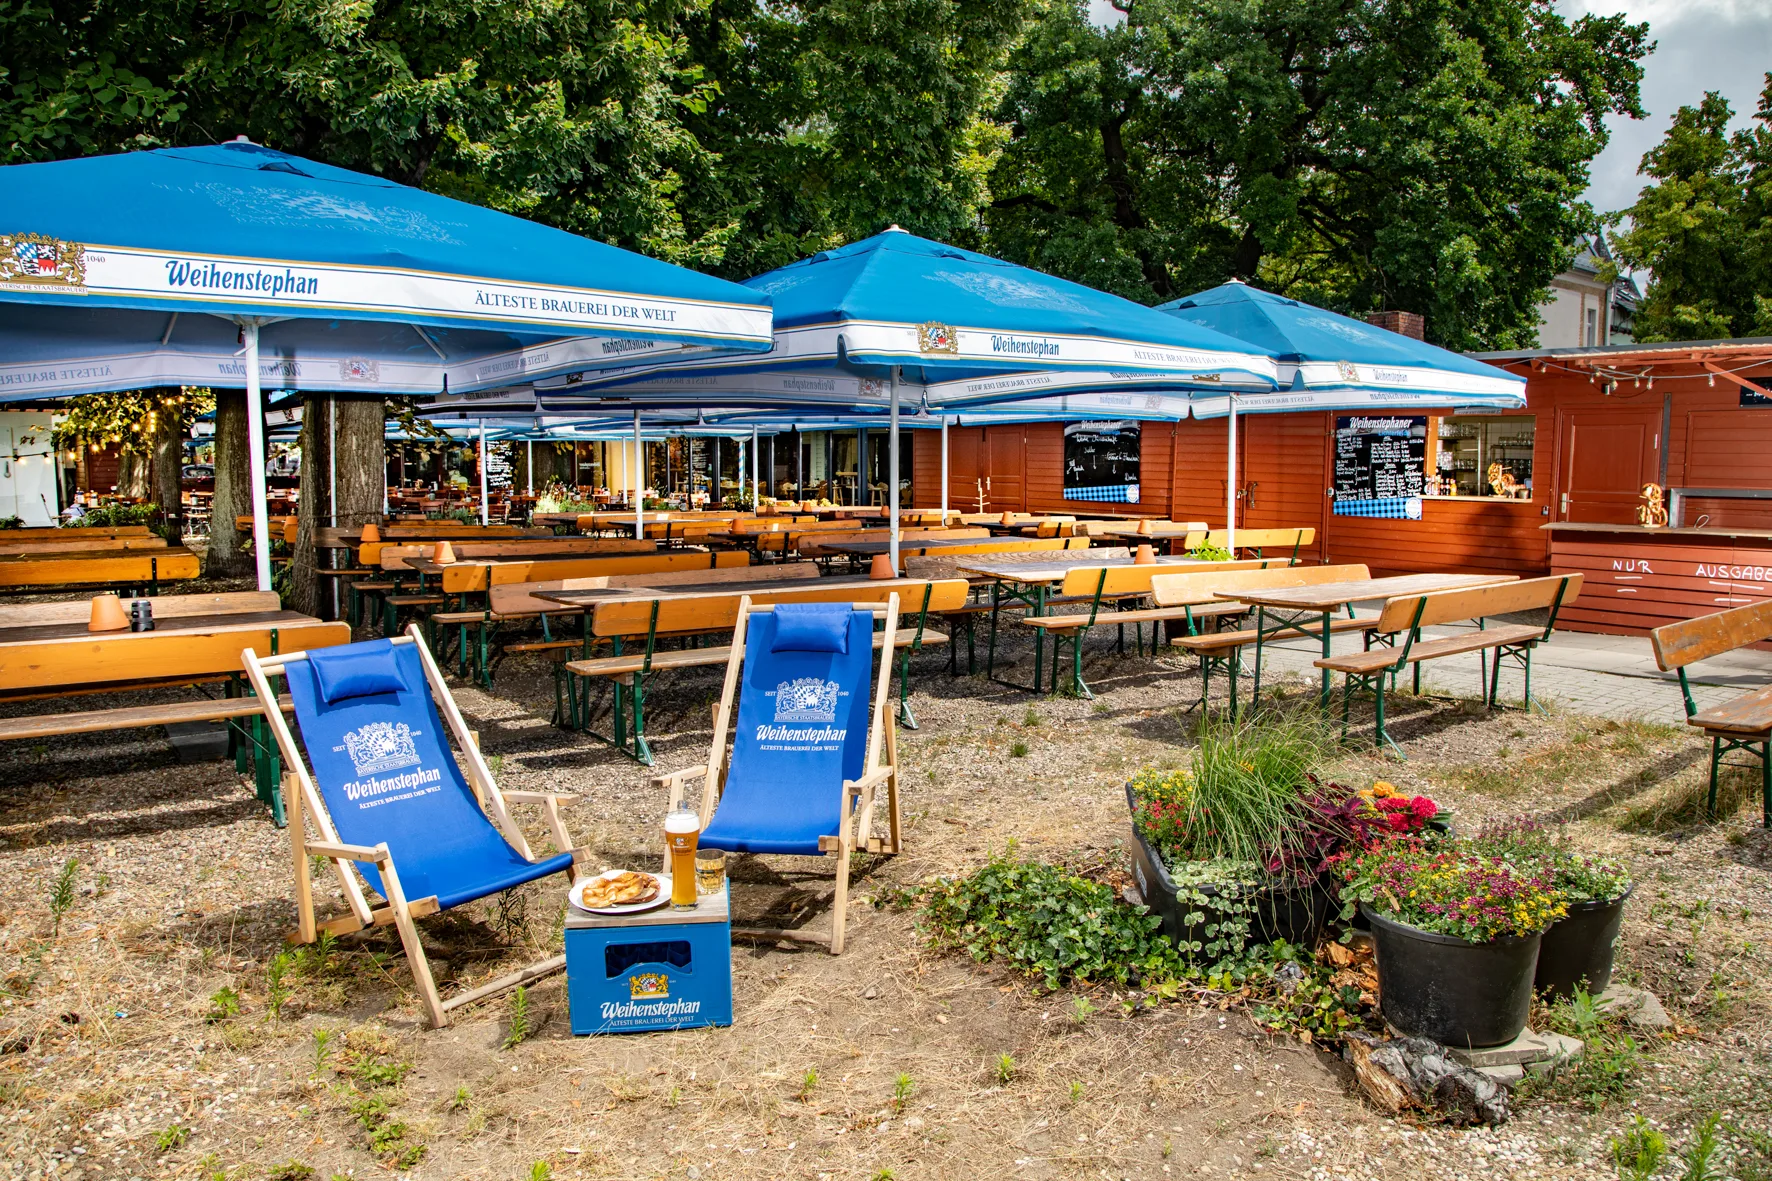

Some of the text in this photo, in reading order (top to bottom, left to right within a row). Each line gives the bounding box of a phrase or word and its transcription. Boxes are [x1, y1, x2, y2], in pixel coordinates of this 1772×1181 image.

[86, 255, 106, 263] 1040
[165, 260, 318, 296] Weihenstephan
[475, 290, 677, 321] ÄLTESTE BRAUEREI DER WELT
[991, 335, 1060, 357] Weihenstephan
[1350, 416, 1413, 430] Weihenstephaner
[1612, 559, 1653, 574] NUR
[1695, 564, 1772, 581] AUSGABE
[756, 724, 847, 744] Weihenstephan
[332, 744, 346, 752] SEIT
[343, 766, 441, 801] Weihenstephan
[384, 793, 413, 804] BRAUEREI
[413, 789, 426, 797] DER
[426, 785, 441, 794] WELT
[600, 998, 700, 1018] Weihenstephan
[634, 1017, 664, 1025] BRAUEREI
